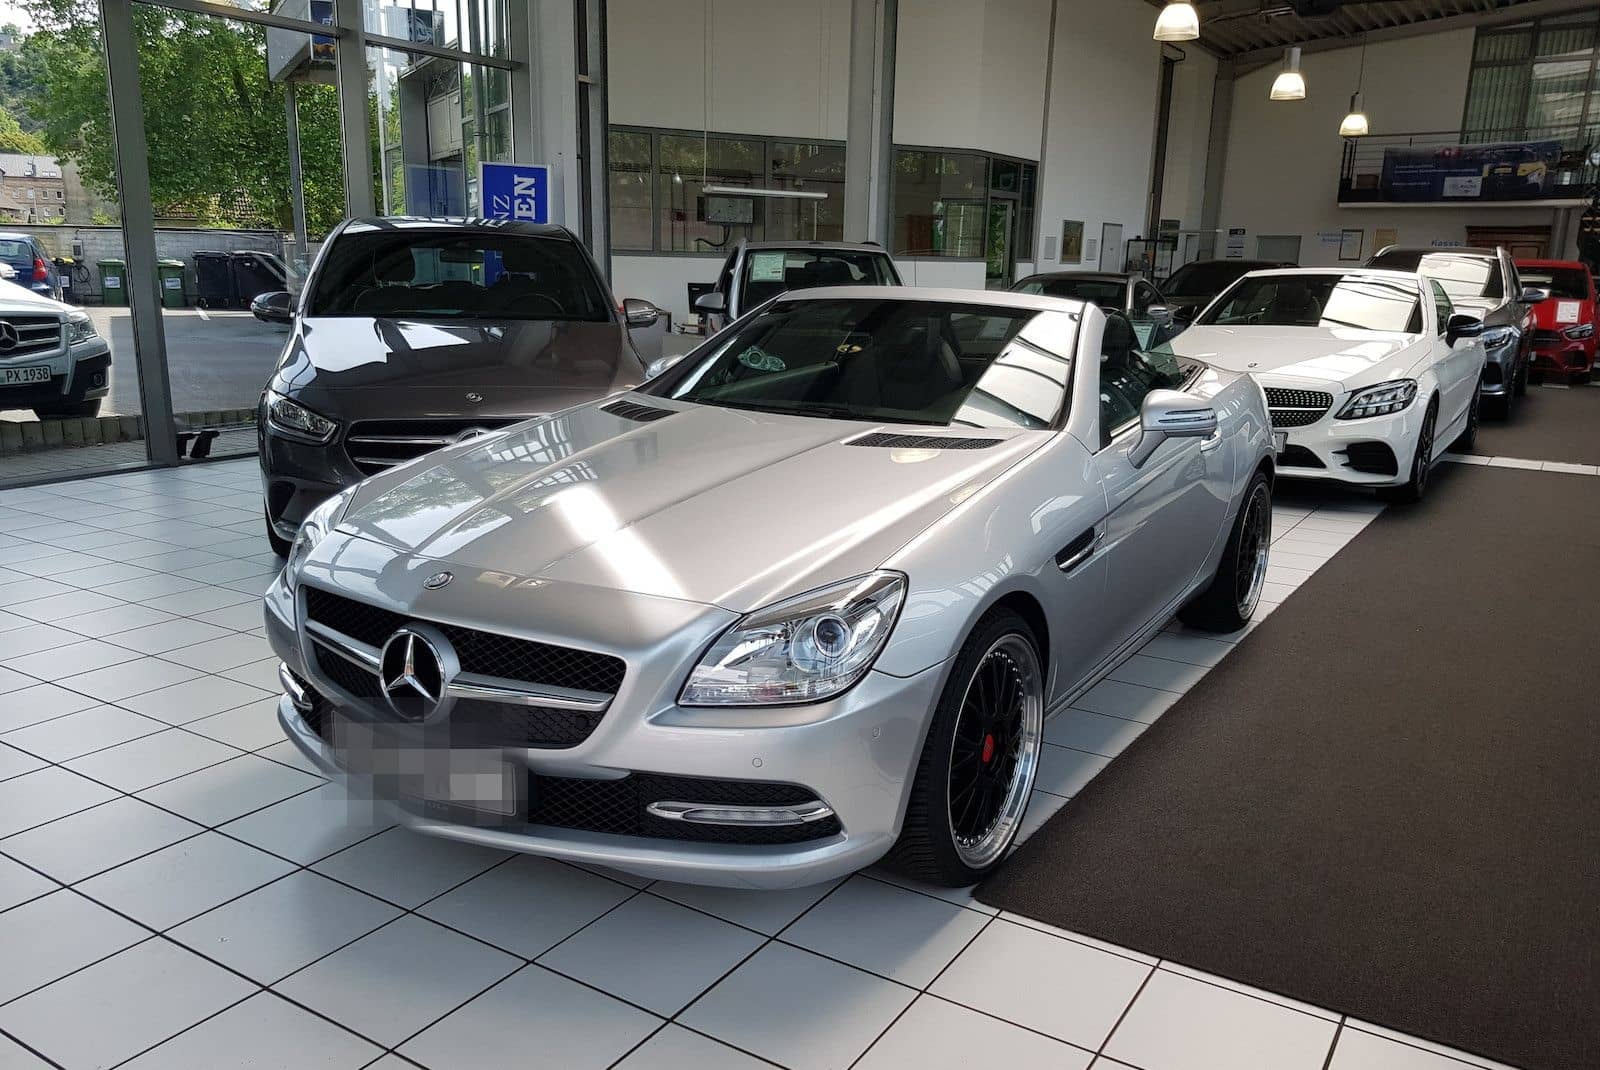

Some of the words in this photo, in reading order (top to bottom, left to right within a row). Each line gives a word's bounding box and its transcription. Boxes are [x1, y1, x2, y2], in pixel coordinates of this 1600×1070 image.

[514, 174, 536, 221] EN
[6, 369, 21, 382] PX
[23, 367, 49, 381] 1938
